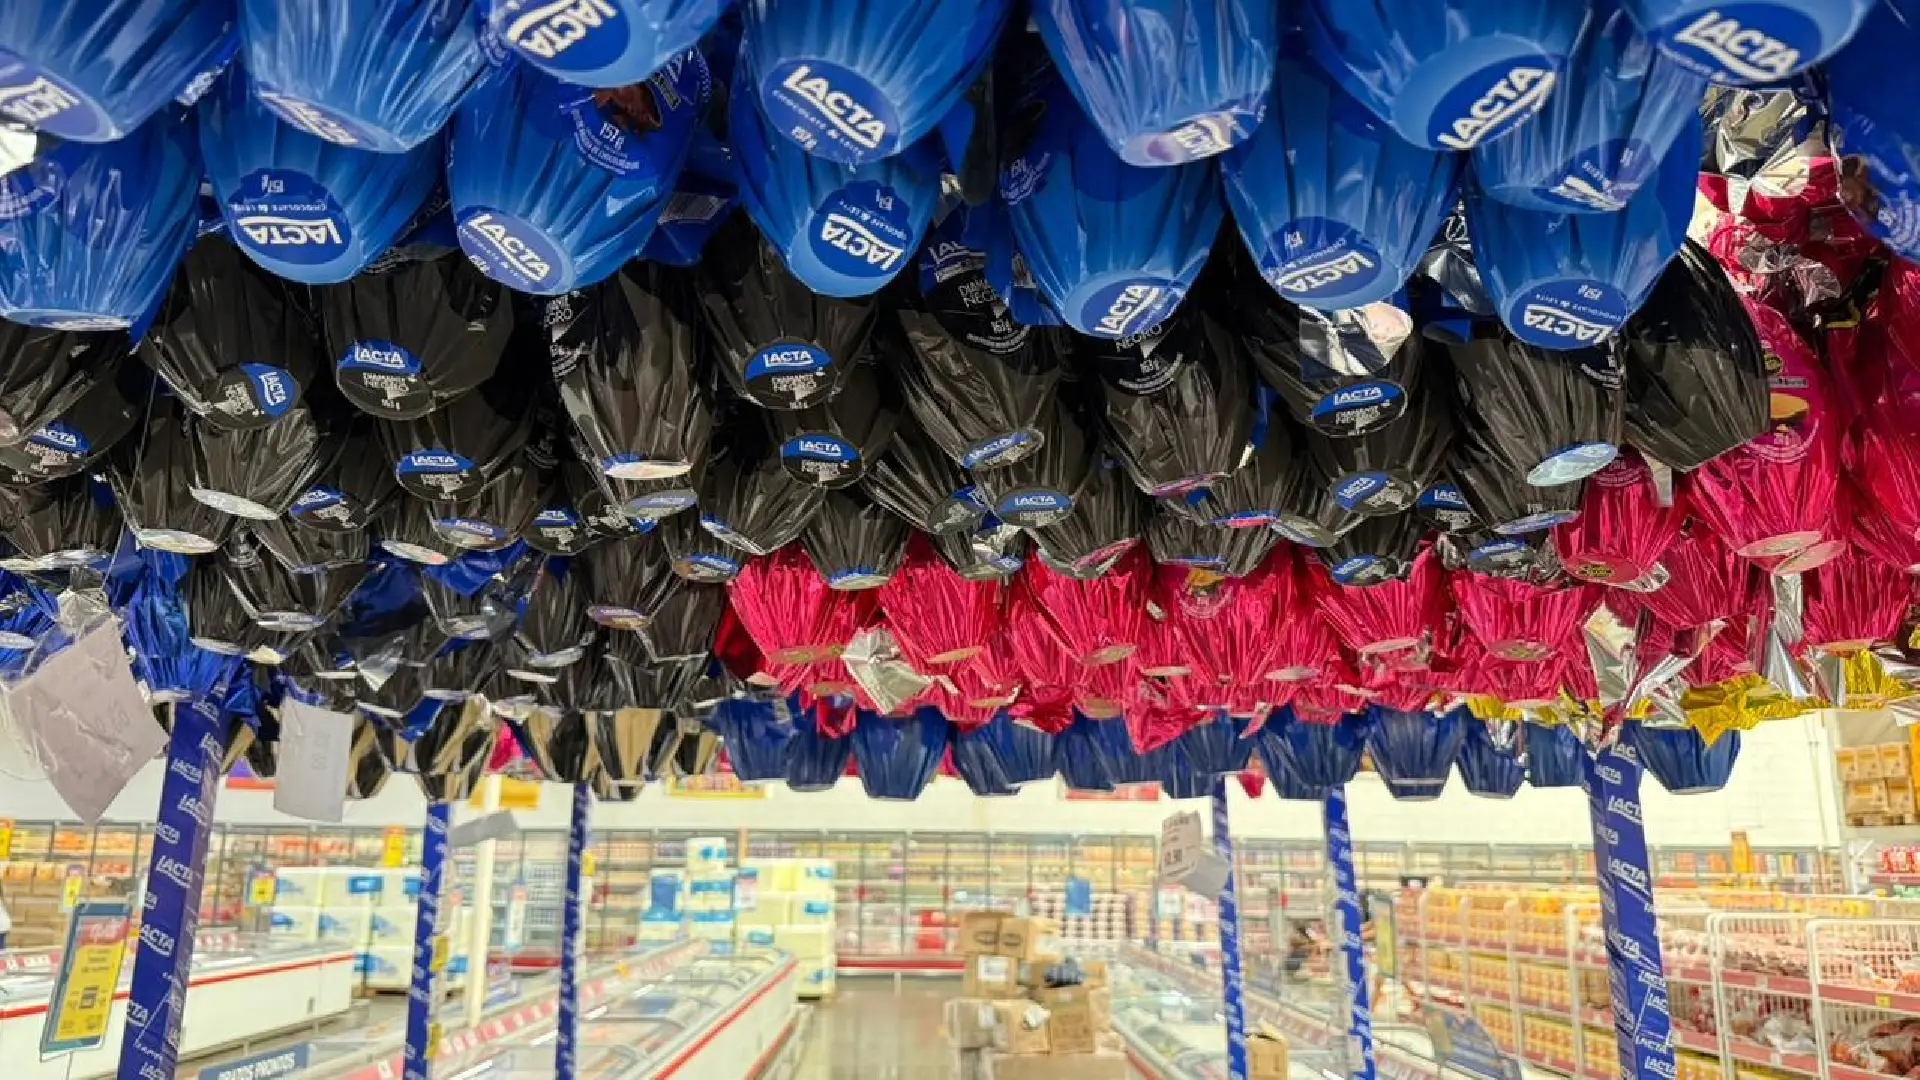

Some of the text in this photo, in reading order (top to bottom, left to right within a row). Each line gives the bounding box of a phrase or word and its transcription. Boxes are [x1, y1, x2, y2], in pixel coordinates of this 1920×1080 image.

[1675, 11, 1801, 83] LACTA
[781, 65, 886, 149] LACTA
[1437, 66, 1559, 149] LACTA
[236, 215, 343, 245] LACTA
[467, 212, 550, 281] LACTA
[821, 212, 904, 271] LACTA
[1275, 250, 1375, 293] LACTA
[1094, 285, 1160, 335] LACTA
[1524, 303, 1616, 345] LACTA
[354, 340, 406, 369] LACTA
[763, 350, 814, 368] LACTA
[258, 371, 287, 406] LACTA
[1333, 387, 1385, 406] LACTA
[410, 454, 458, 467] LACTA
[800, 440, 841, 457] LACTA
[1014, 494, 1058, 506] LACTA
[1434, 489, 1464, 505] LAC
[170, 757, 202, 785] LACTA
[1610, 742, 1637, 766] LAC
[1607, 855, 1651, 892] LACTA
[141, 923, 175, 957] ACTA
